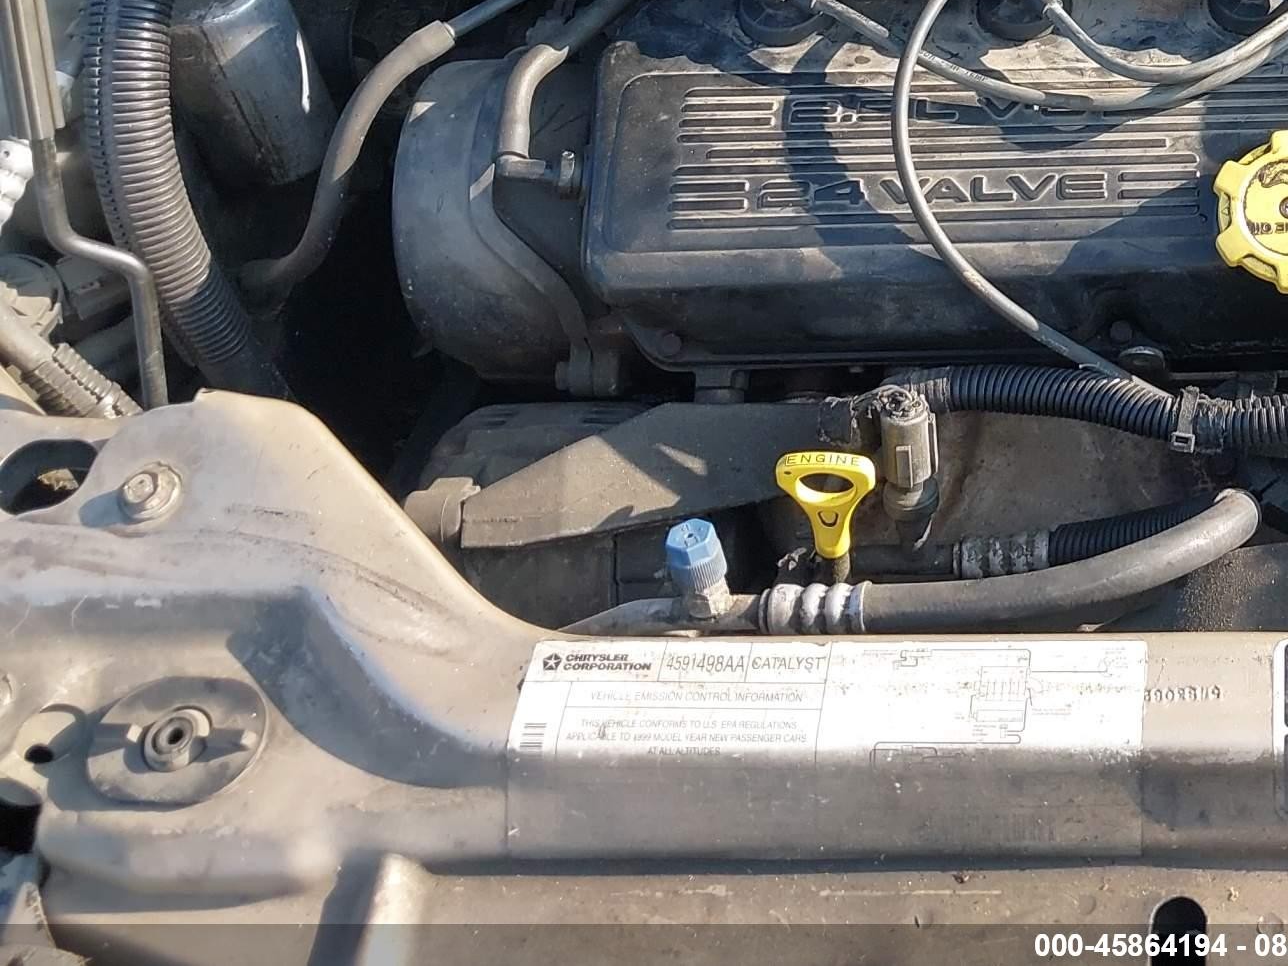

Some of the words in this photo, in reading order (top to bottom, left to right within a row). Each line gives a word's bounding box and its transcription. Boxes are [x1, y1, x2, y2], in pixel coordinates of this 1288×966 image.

[880, 172, 1107, 205] VALVE
[787, 454, 860, 466] ENGINE
[565, 653, 629, 662] CHRYSLER
[666, 651, 745, 673] 4591498AA
[751, 654, 825, 672] CATALYST
[563, 662, 652, 671] CORPORATION
[634, 690, 684, 701] EMISSION
[685, 691, 733, 702] CONTROL
[735, 691, 803, 703] INFORMATION
[581, 719, 600, 728] THIS
[640, 720, 687, 728] CONFORMS
[689, 720, 701, 729] TO
[721, 721, 737, 729] EPA
[740, 721, 798, 730] REGULATIONS
[619, 733, 632, 741] TO
[653, 733, 682, 742] MODEL
[685, 733, 707, 742] YEAR
[708, 733, 729, 742] NEW
[730, 733, 781, 743] PASSENGER
[783, 734, 807, 743] CARS
